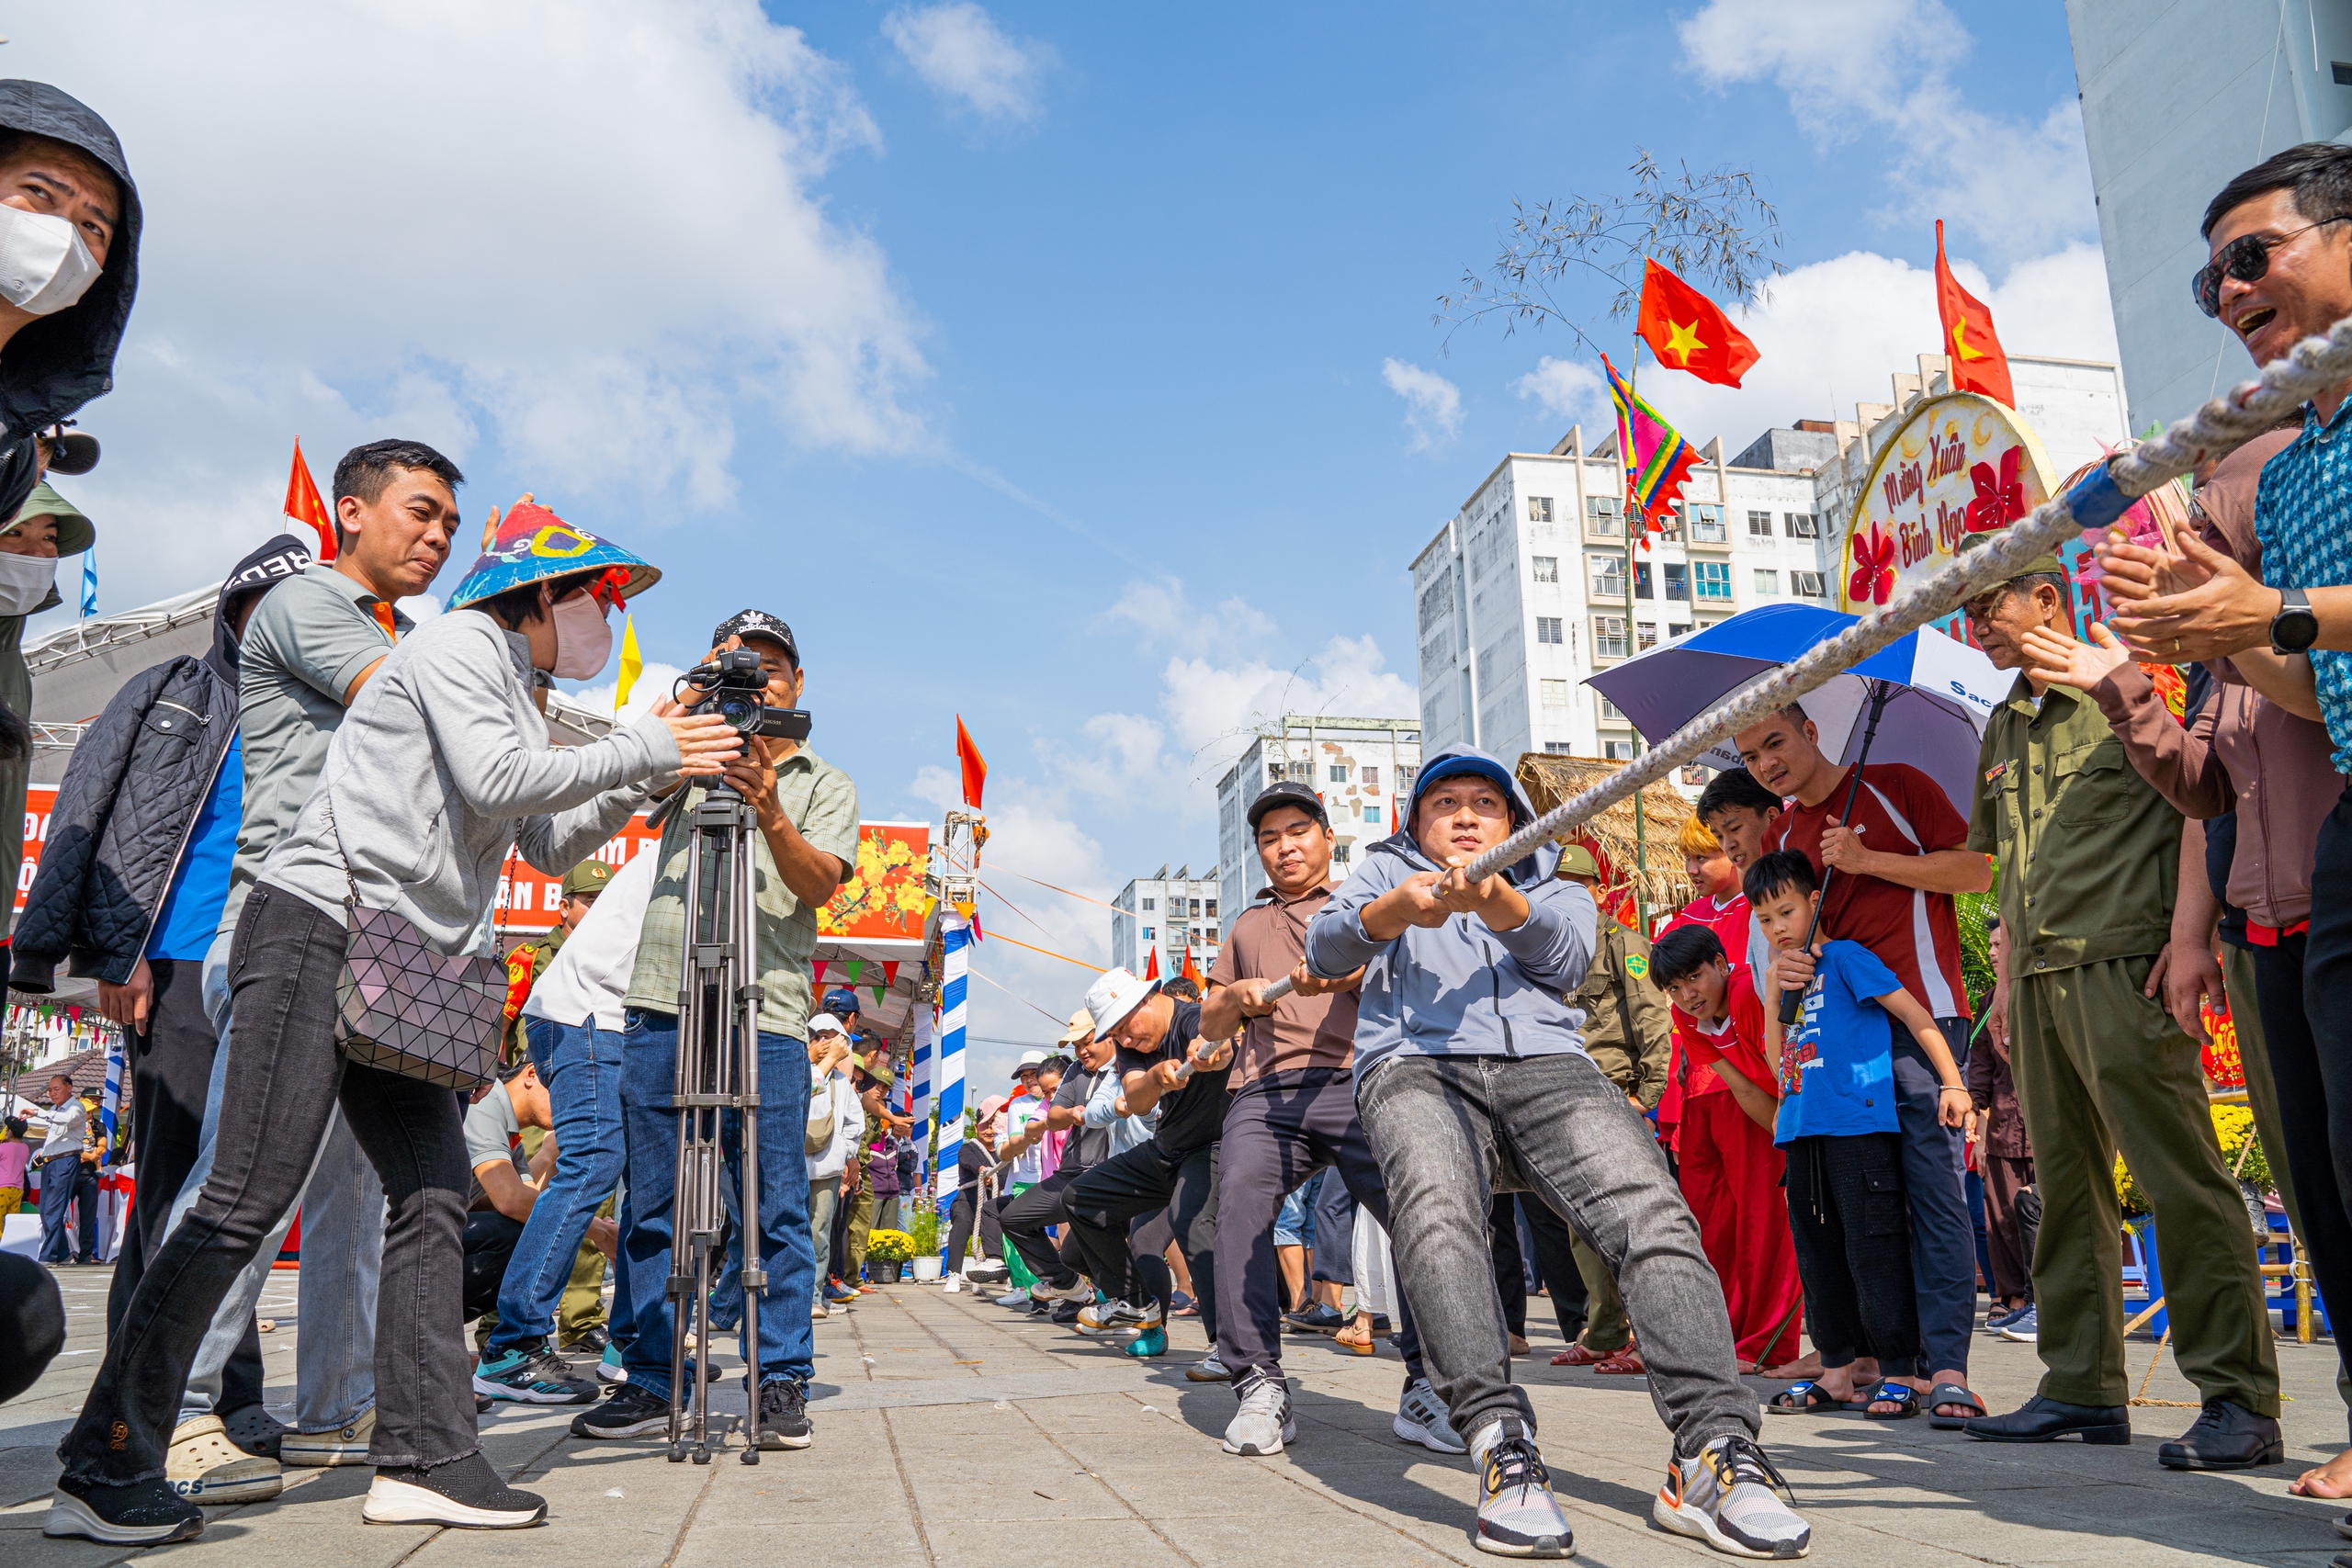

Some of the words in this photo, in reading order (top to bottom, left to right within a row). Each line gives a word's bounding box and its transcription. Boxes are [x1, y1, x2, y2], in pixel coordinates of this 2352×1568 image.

[1928, 433, 1965, 481] Xuân
[738, 624, 771, 633] adidas
[1950, 681, 1996, 708] Sac
[494, 875, 533, 911] ÂN
